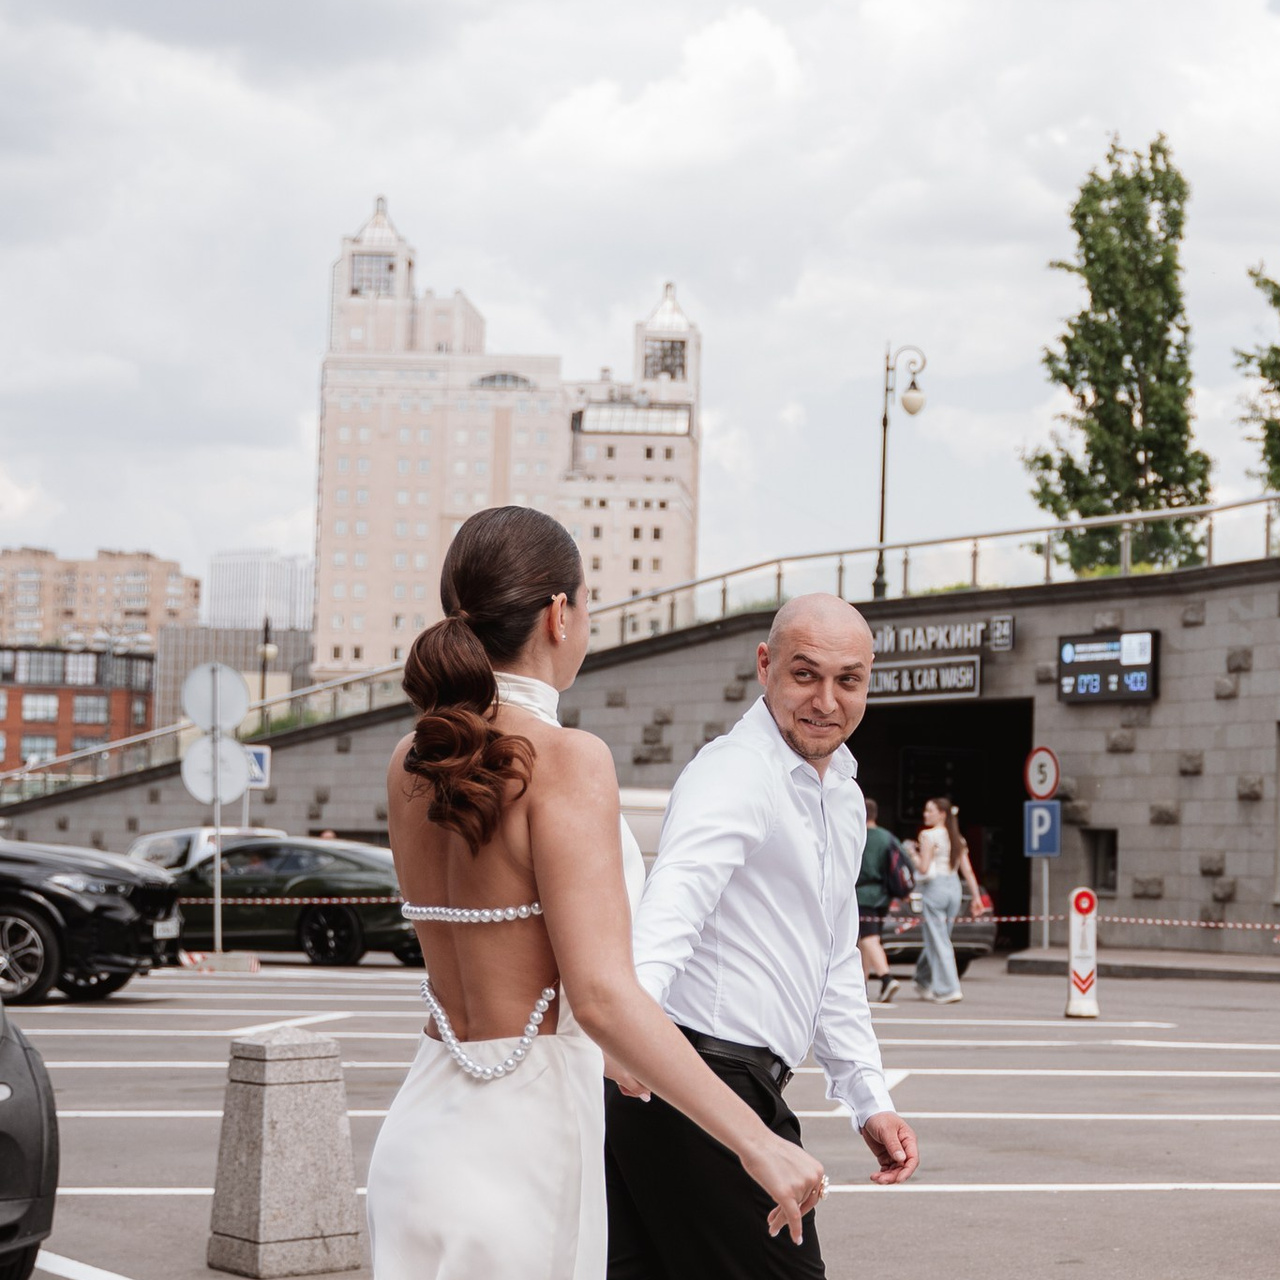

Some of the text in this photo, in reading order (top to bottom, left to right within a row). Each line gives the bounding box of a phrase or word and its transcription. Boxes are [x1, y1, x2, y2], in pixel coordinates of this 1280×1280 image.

[900, 622, 986, 653] ПАРКИНГ
[913, 667, 937, 690] CAR
[939, 666, 974, 688] WASH
[1037, 762, 1048, 785] 5
[1031, 807, 1051, 850] P
